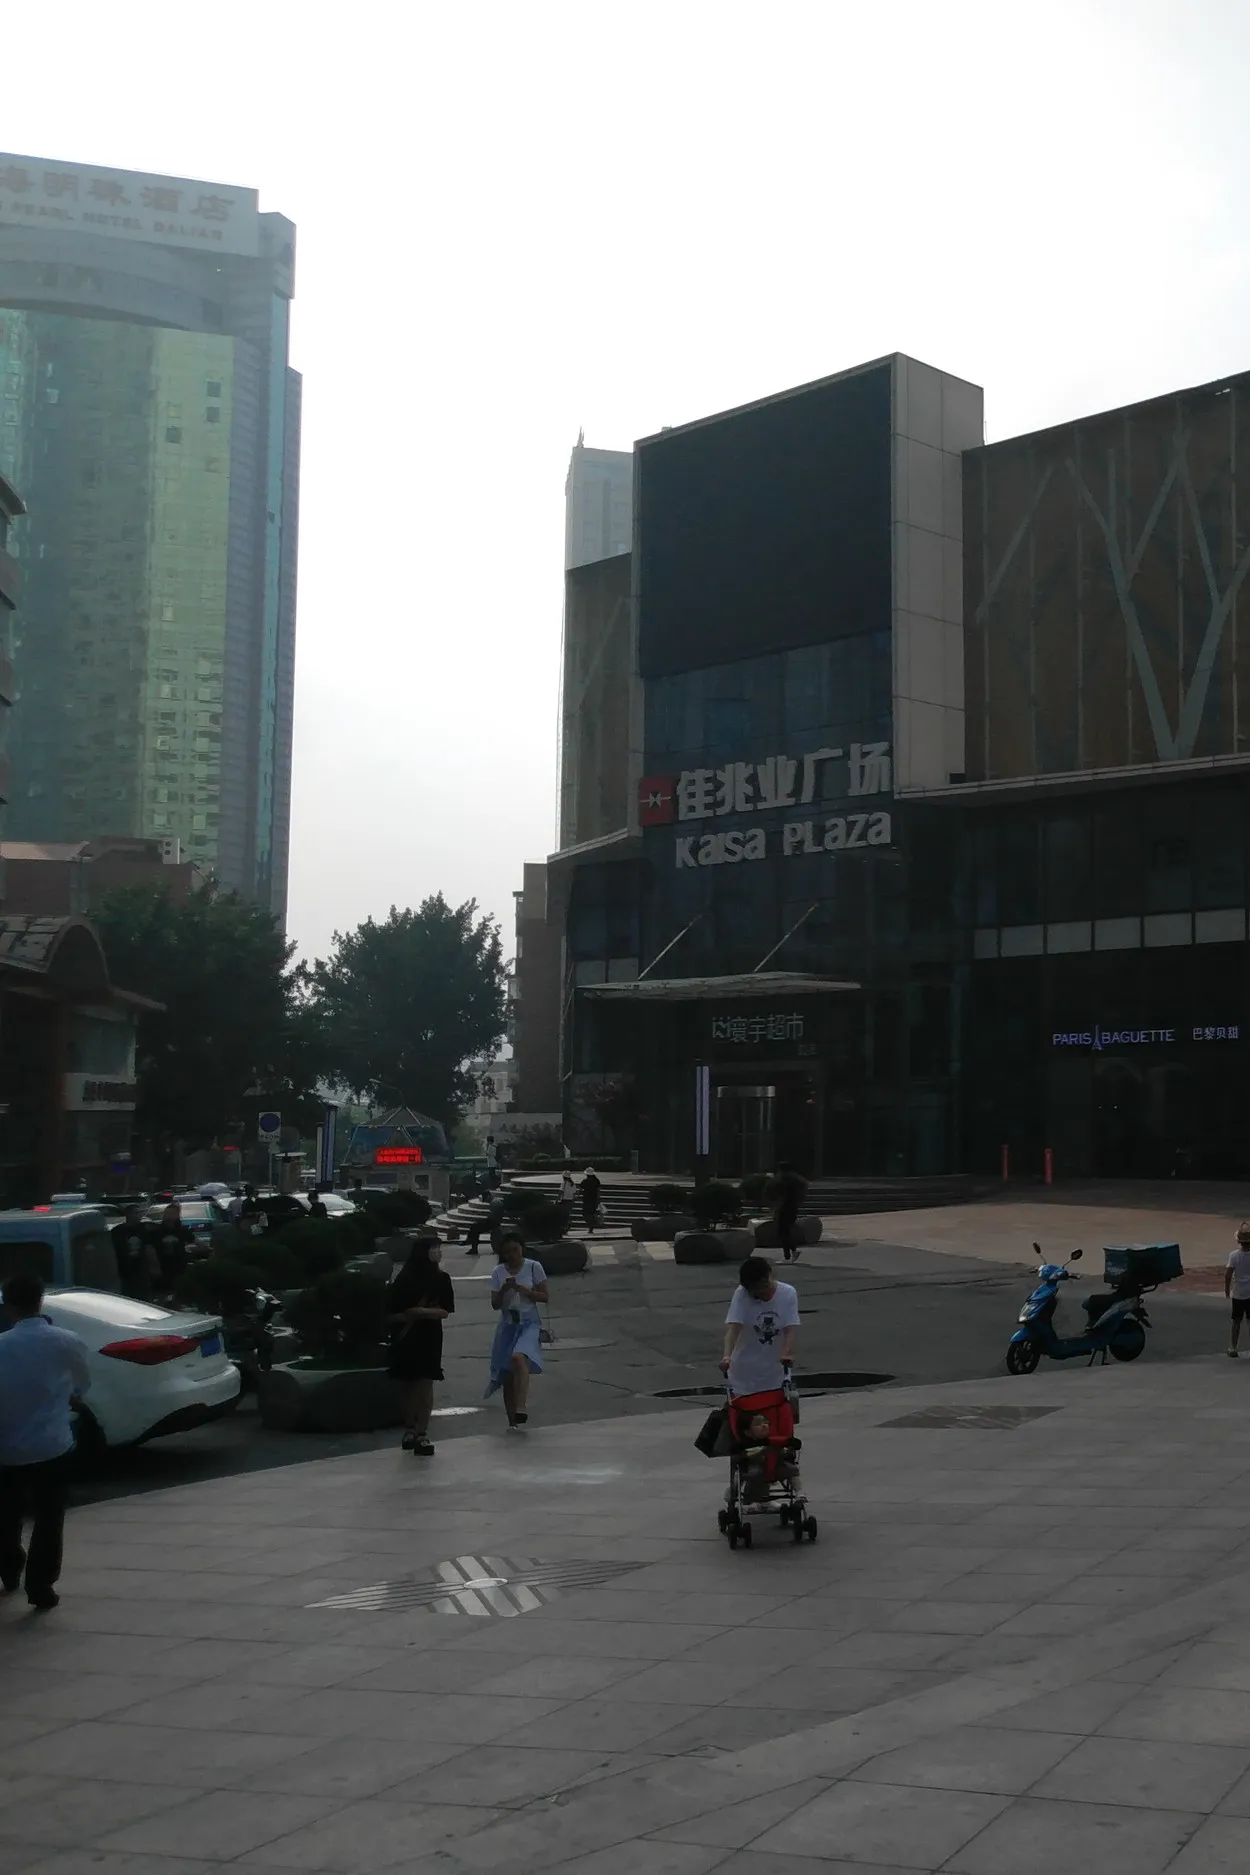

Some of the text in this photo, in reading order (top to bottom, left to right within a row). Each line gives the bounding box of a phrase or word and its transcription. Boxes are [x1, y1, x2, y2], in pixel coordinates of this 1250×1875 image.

[82, 212, 144, 230] HOTEL
[153, 221, 223, 241] DALIAN
[676, 741, 892, 821] 佳兆业广场
[1052, 1028, 1175, 1046] PARIS BAGUETTE
[1192, 1025, 1240, 1041] 巴黎贝甜
